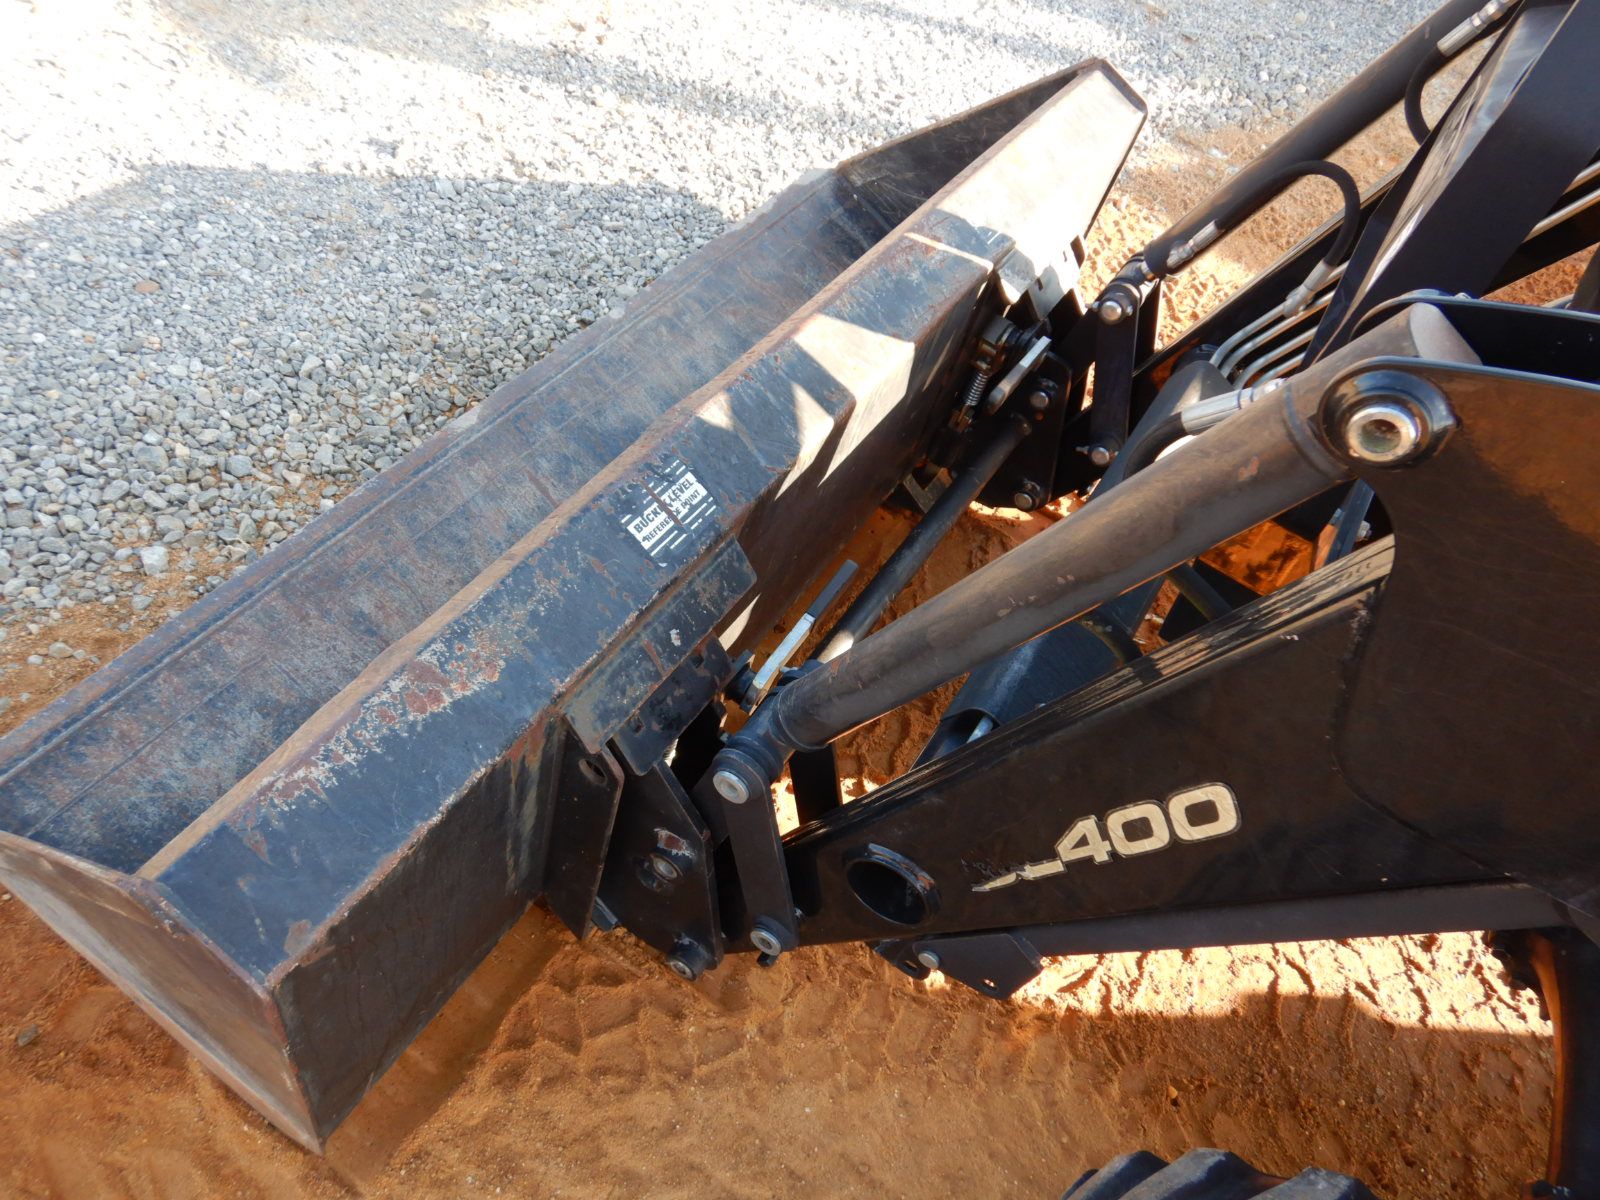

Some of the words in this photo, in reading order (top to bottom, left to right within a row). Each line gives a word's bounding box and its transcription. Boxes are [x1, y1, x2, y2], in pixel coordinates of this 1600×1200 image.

[633, 498, 670, 534] BUCK
[668, 478, 694, 503] LEVEL
[645, 507, 681, 542] REFEREE
[680, 489, 701, 510] POINT
